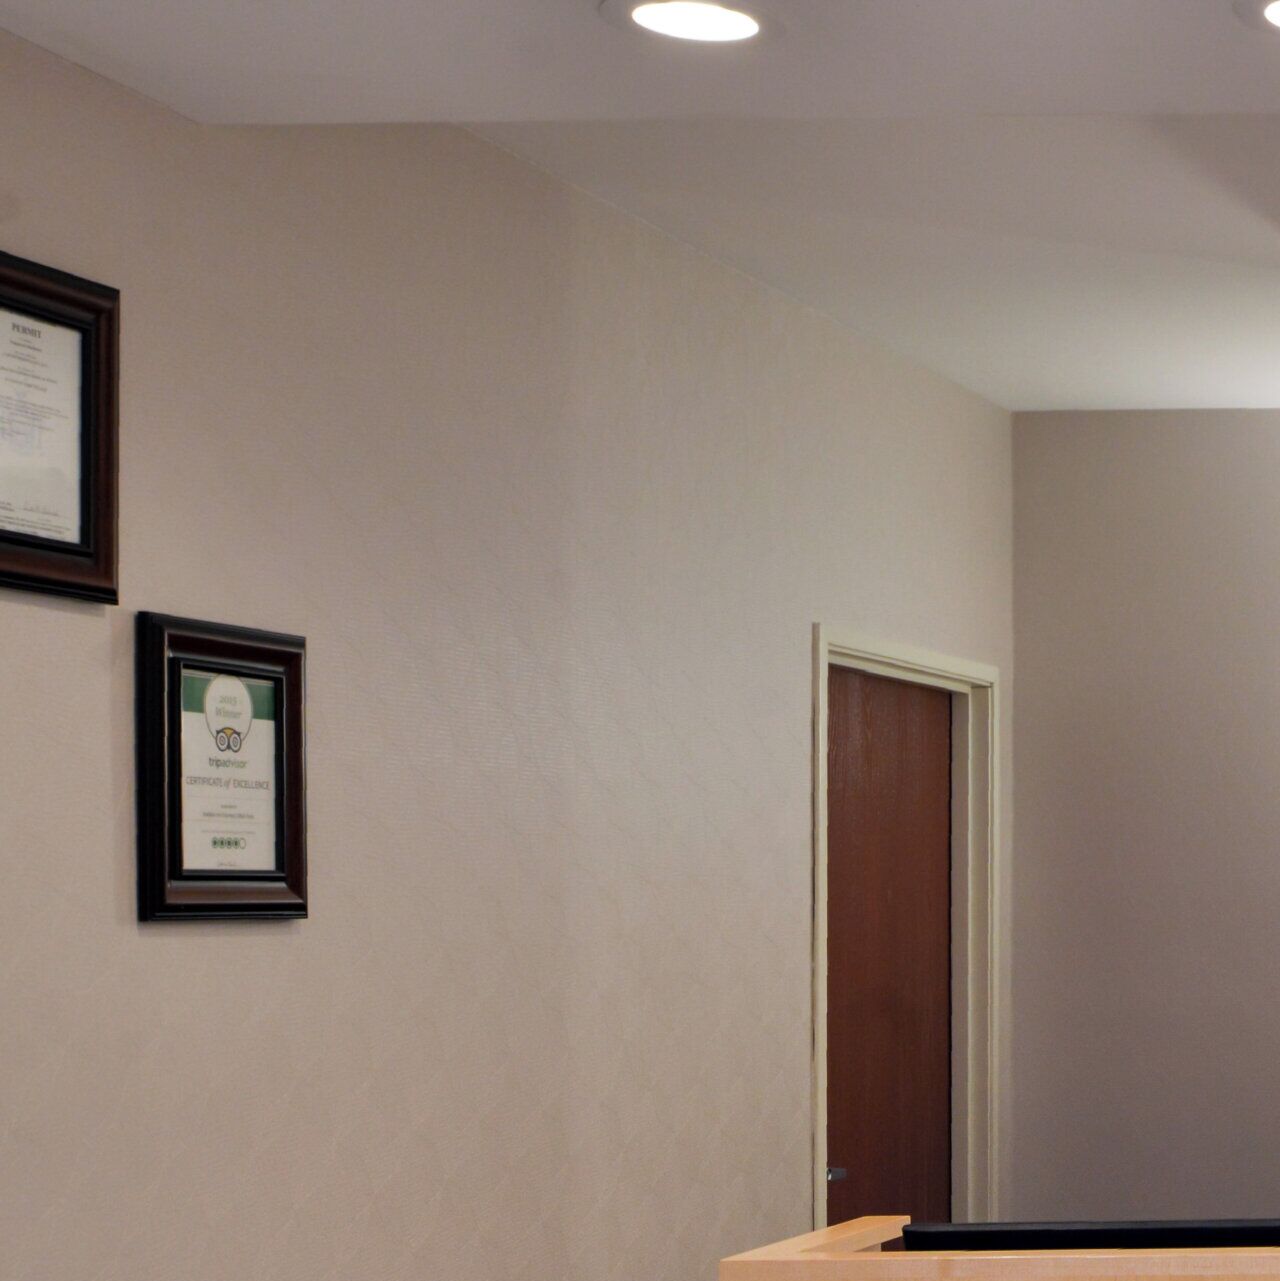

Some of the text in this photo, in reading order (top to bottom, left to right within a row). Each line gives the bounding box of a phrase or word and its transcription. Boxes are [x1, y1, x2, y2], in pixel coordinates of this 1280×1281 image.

[12, 322, 42, 339] PERMIT
[208, 757, 248, 770] tripadvisor
[185, 776, 223, 788] CERTIFICATE
[232, 779, 271, 791] EXCELLENCE
